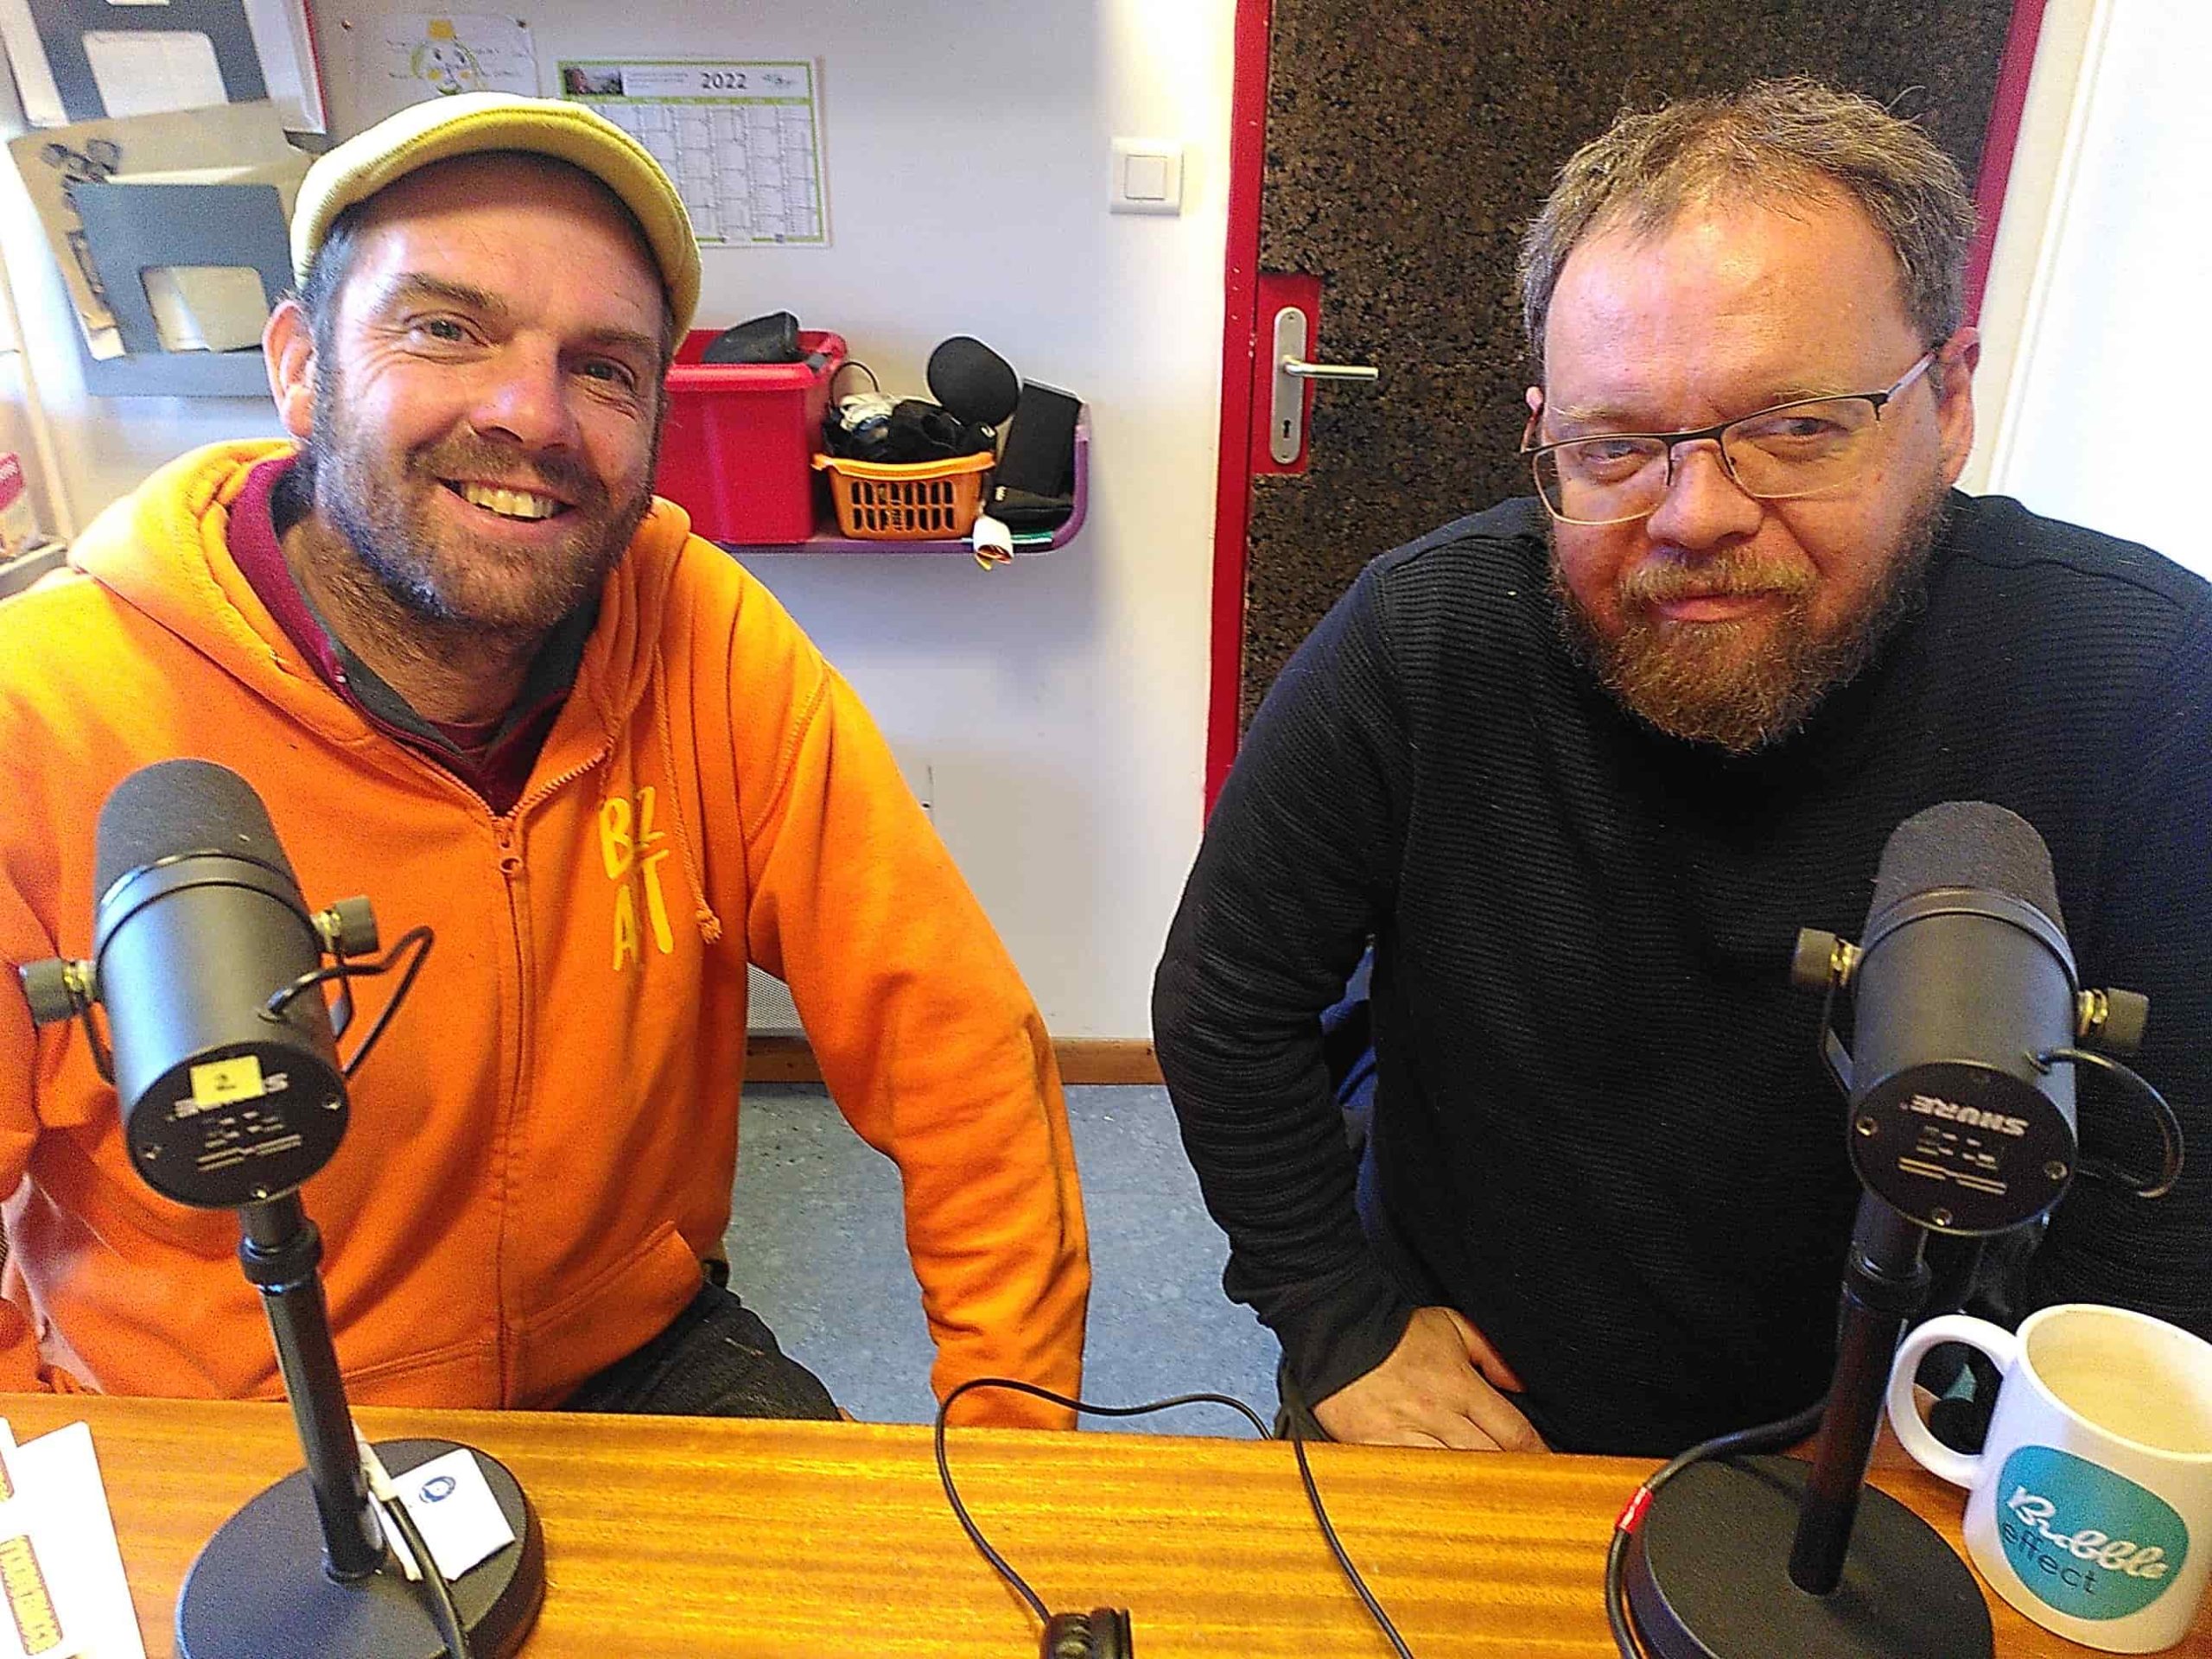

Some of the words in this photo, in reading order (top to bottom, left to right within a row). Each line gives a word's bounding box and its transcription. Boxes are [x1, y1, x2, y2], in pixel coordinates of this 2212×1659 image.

[701, 73, 747, 89] 2022
[1910, 1094, 2030, 1137] SHURE
[2004, 1522, 2097, 1595] effect
